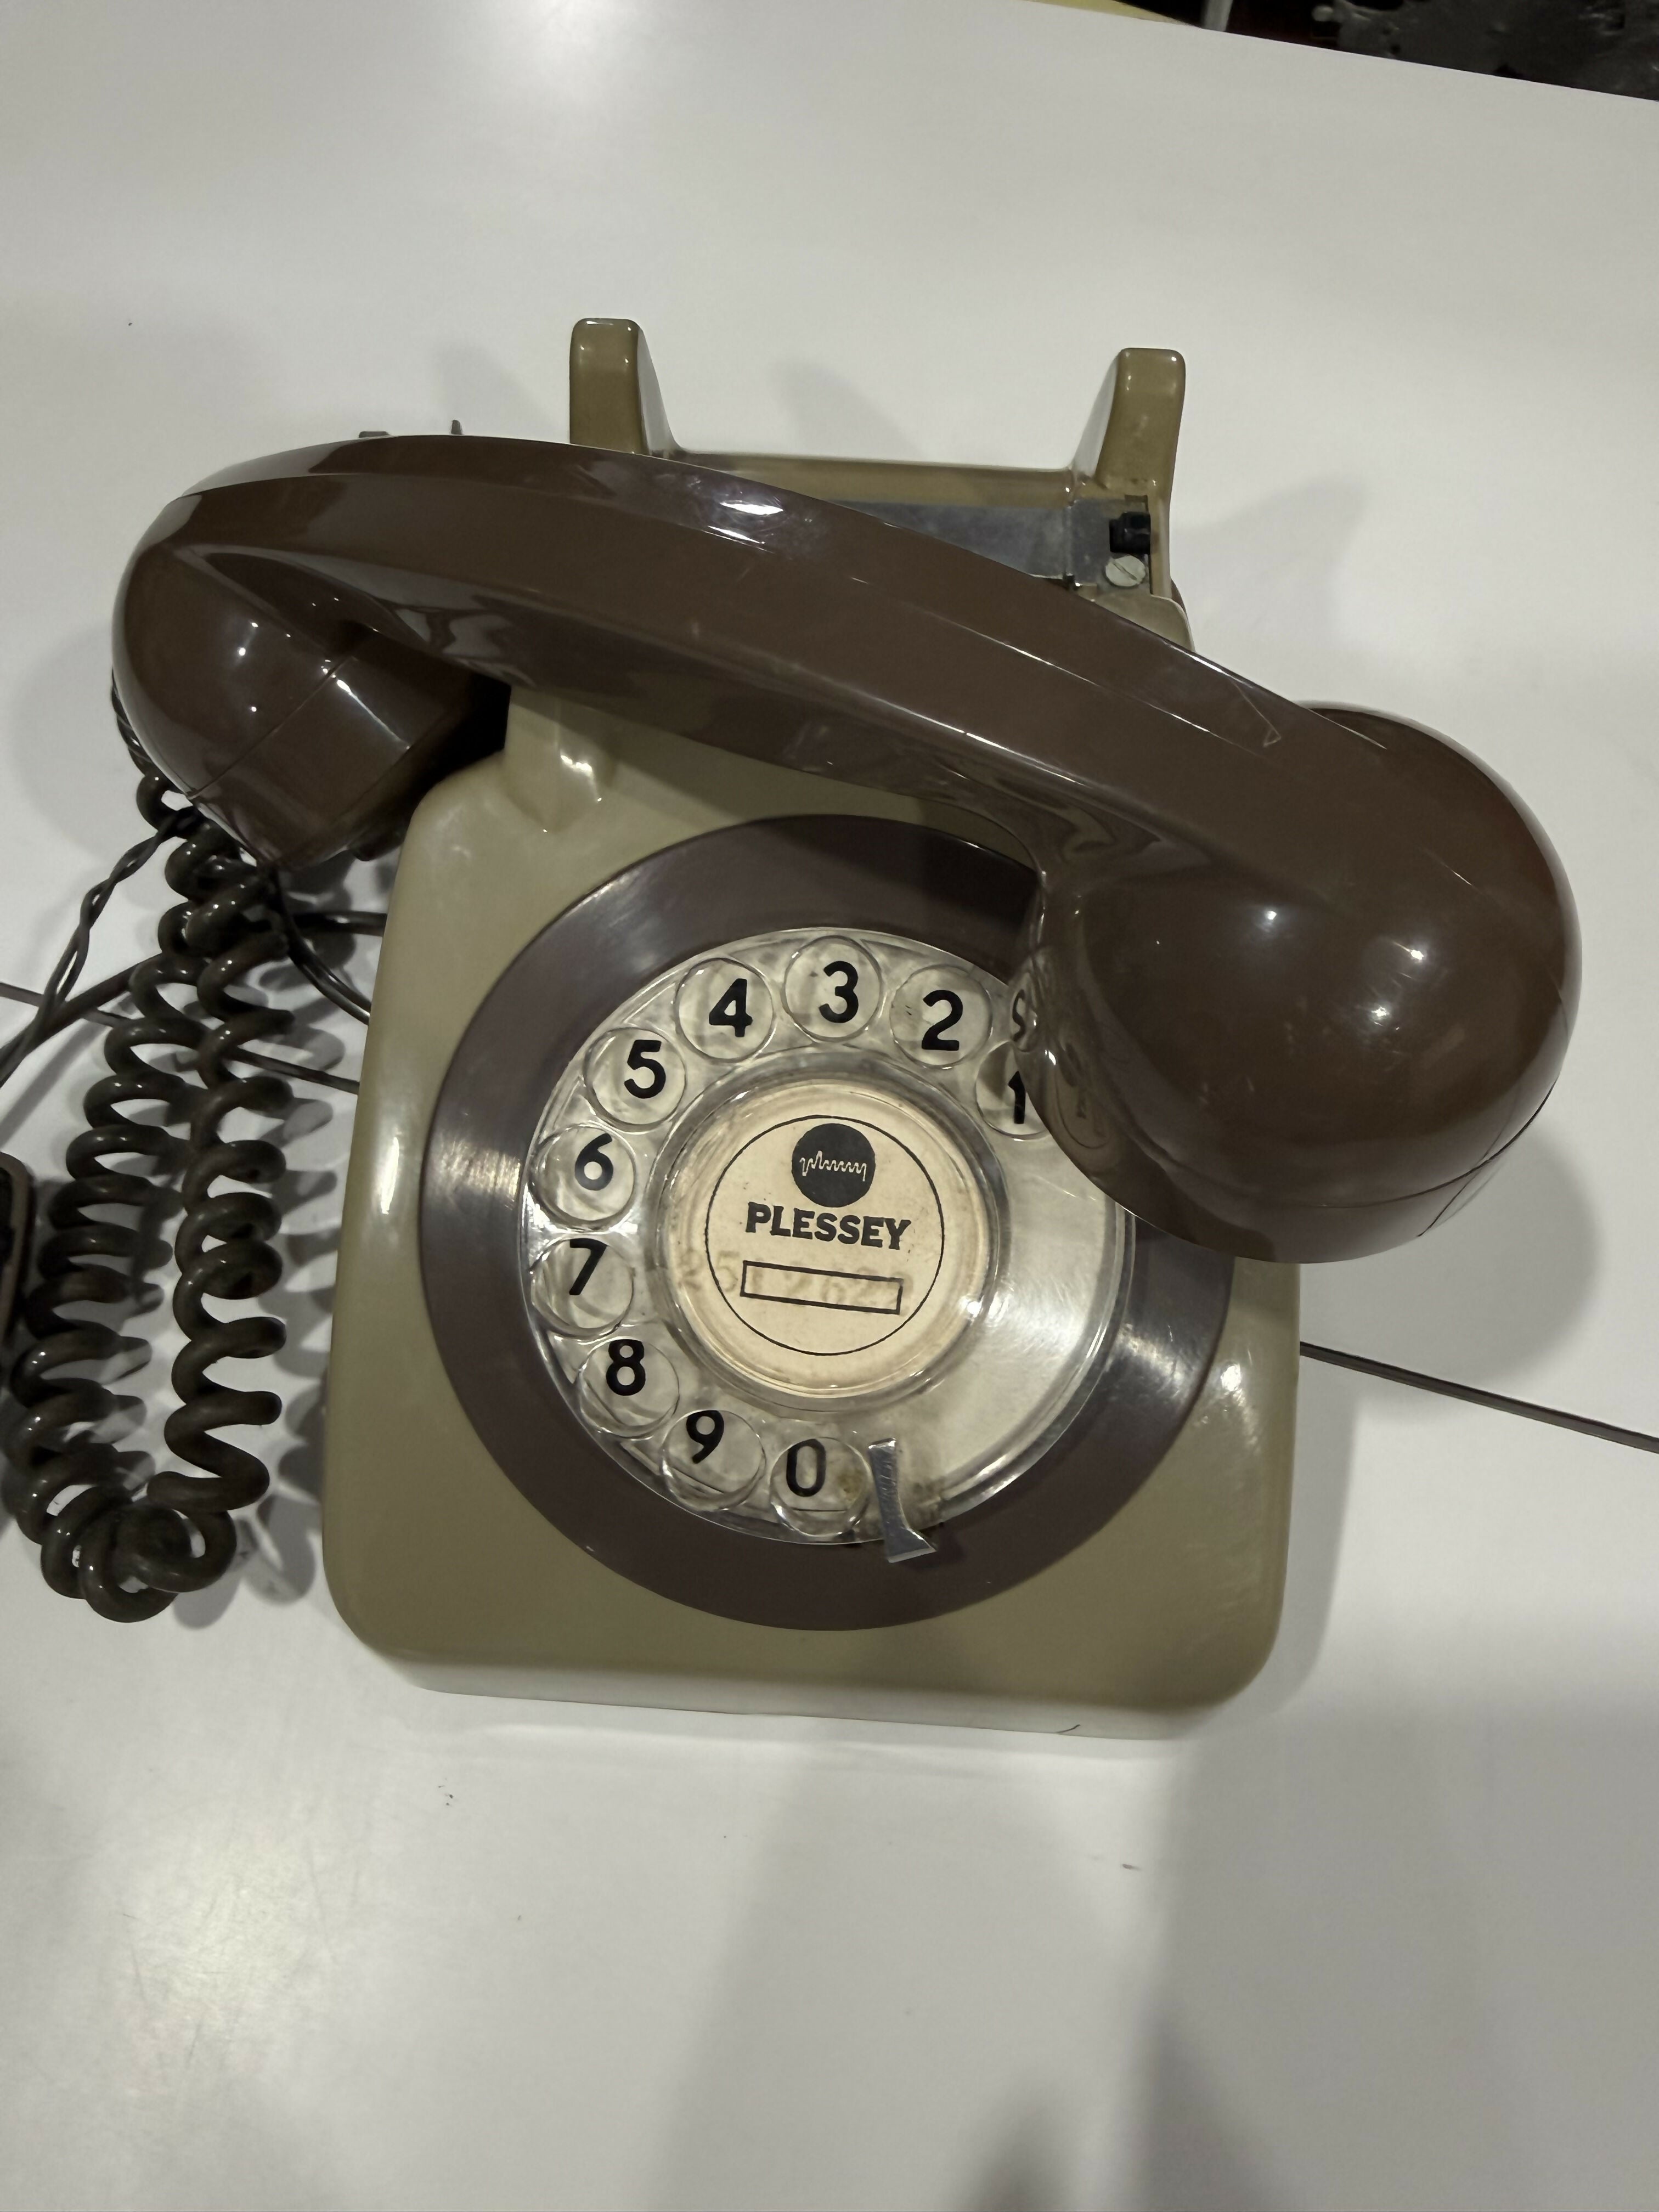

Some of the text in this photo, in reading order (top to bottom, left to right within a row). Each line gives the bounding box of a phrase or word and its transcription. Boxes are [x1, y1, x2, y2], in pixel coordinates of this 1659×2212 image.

[708, 978, 753, 1037] 4
[819, 961, 859, 1024] 3
[921, 990, 963, 1052] 2
[624, 1039, 666, 1099] 5
[1008, 1070, 1027, 1125] 1
[574, 1133, 613, 1190] 6
[745, 1201, 912, 1250] PLESSEY
[568, 1238, 607, 1296] 7
[605, 1339, 646, 1396] 8
[685, 1410, 725, 1464] 9
[786, 1438, 826, 1498] 0
